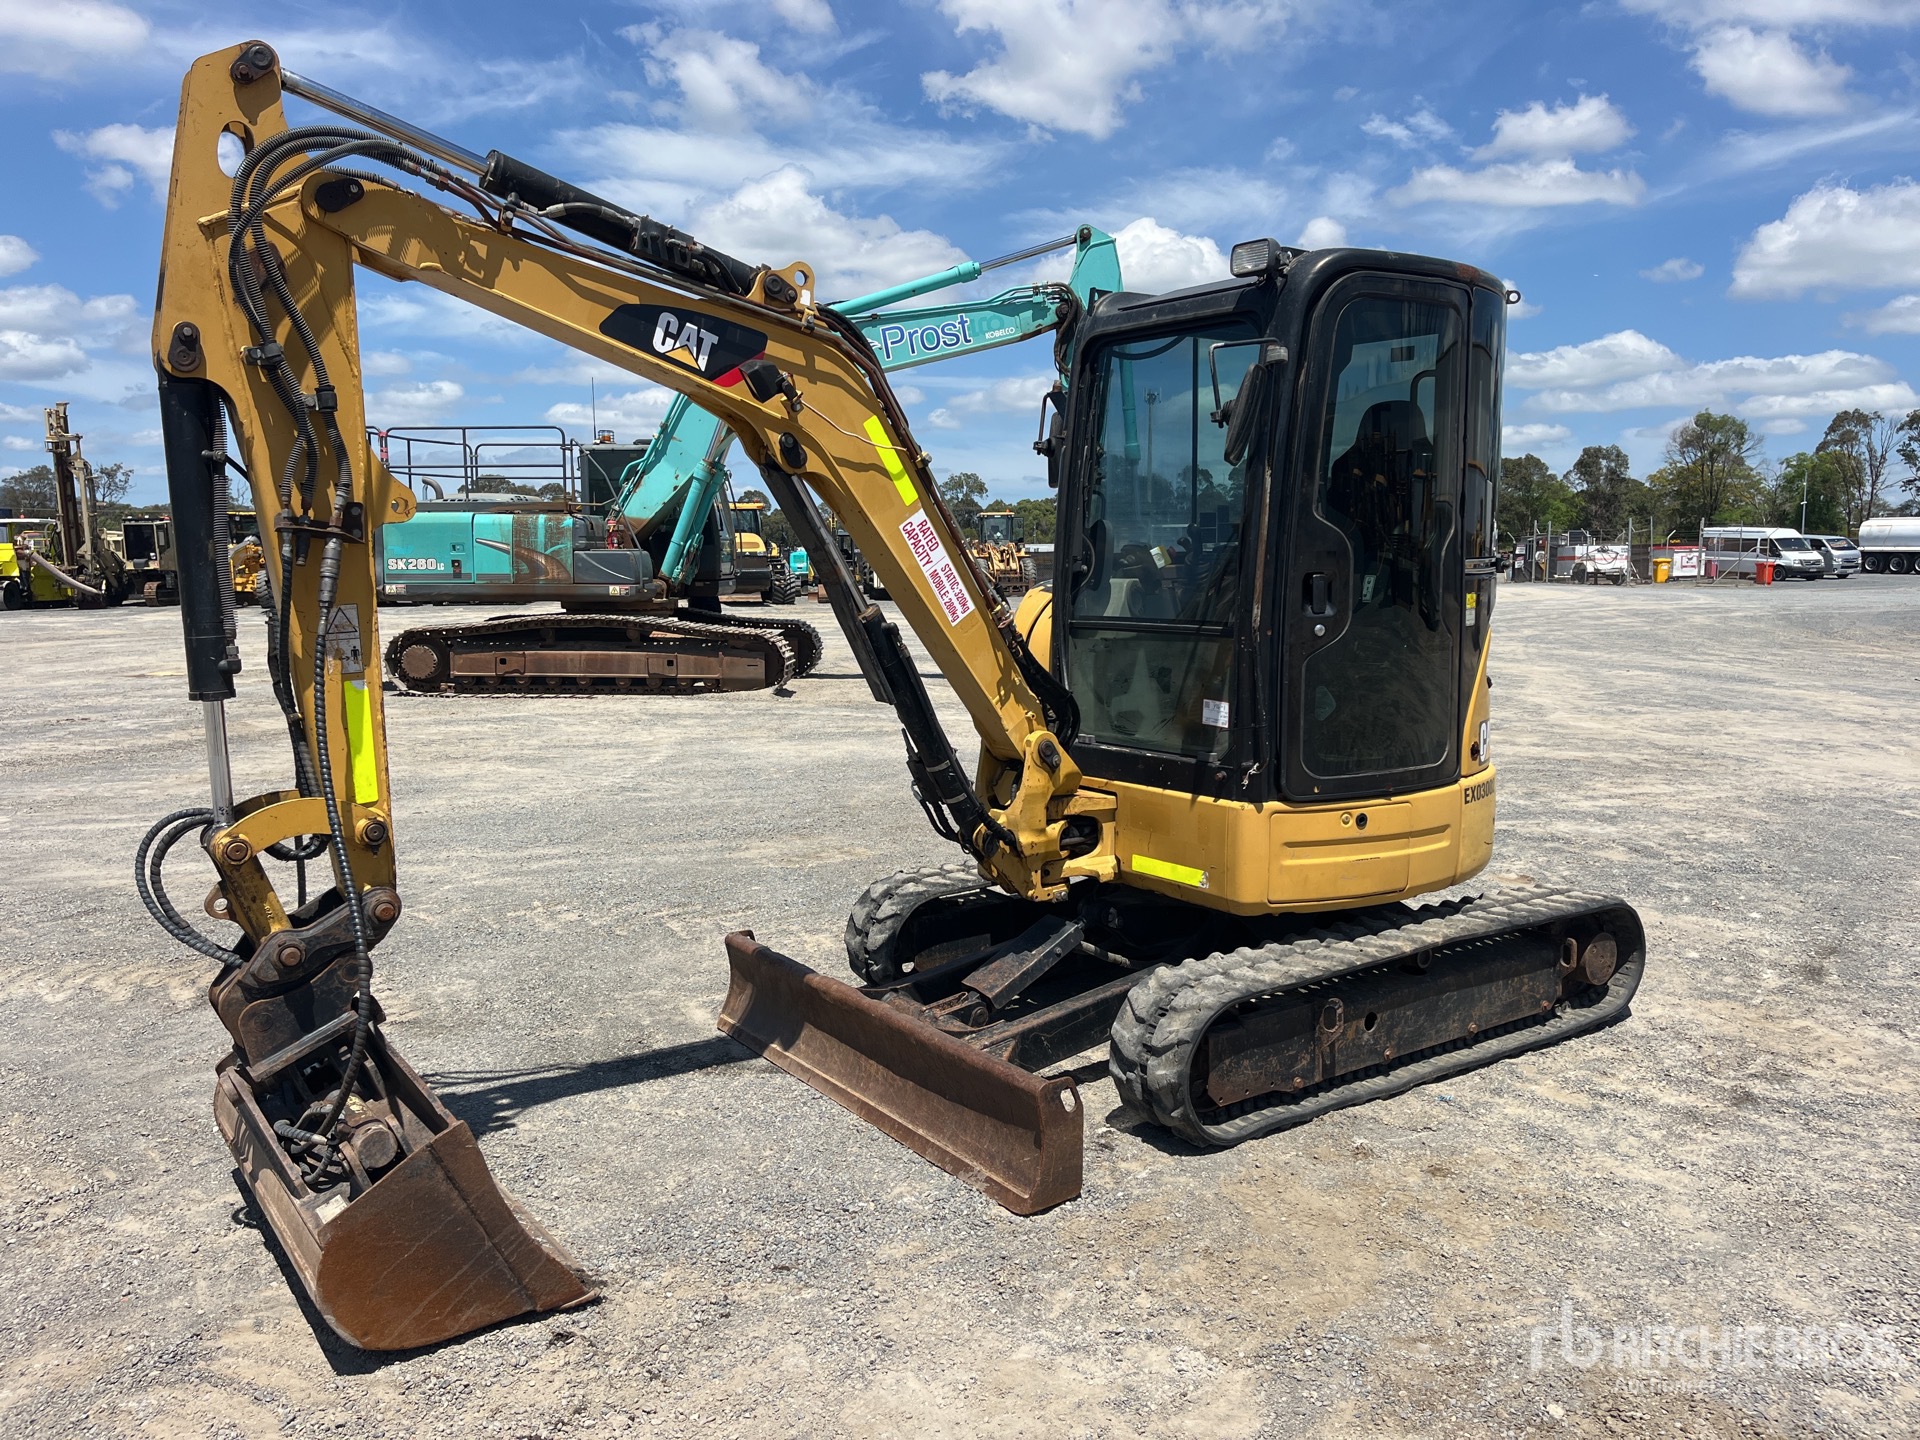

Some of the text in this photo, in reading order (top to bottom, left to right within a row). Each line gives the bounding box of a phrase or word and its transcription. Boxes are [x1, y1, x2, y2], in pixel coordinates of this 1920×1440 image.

[652, 311, 719, 372] CAT
[880, 313, 973, 360] Prost
[985, 326, 1015, 340] KOBELCO
[902, 521, 933, 567] CAPACITY
[916, 519, 940, 552] RATED
